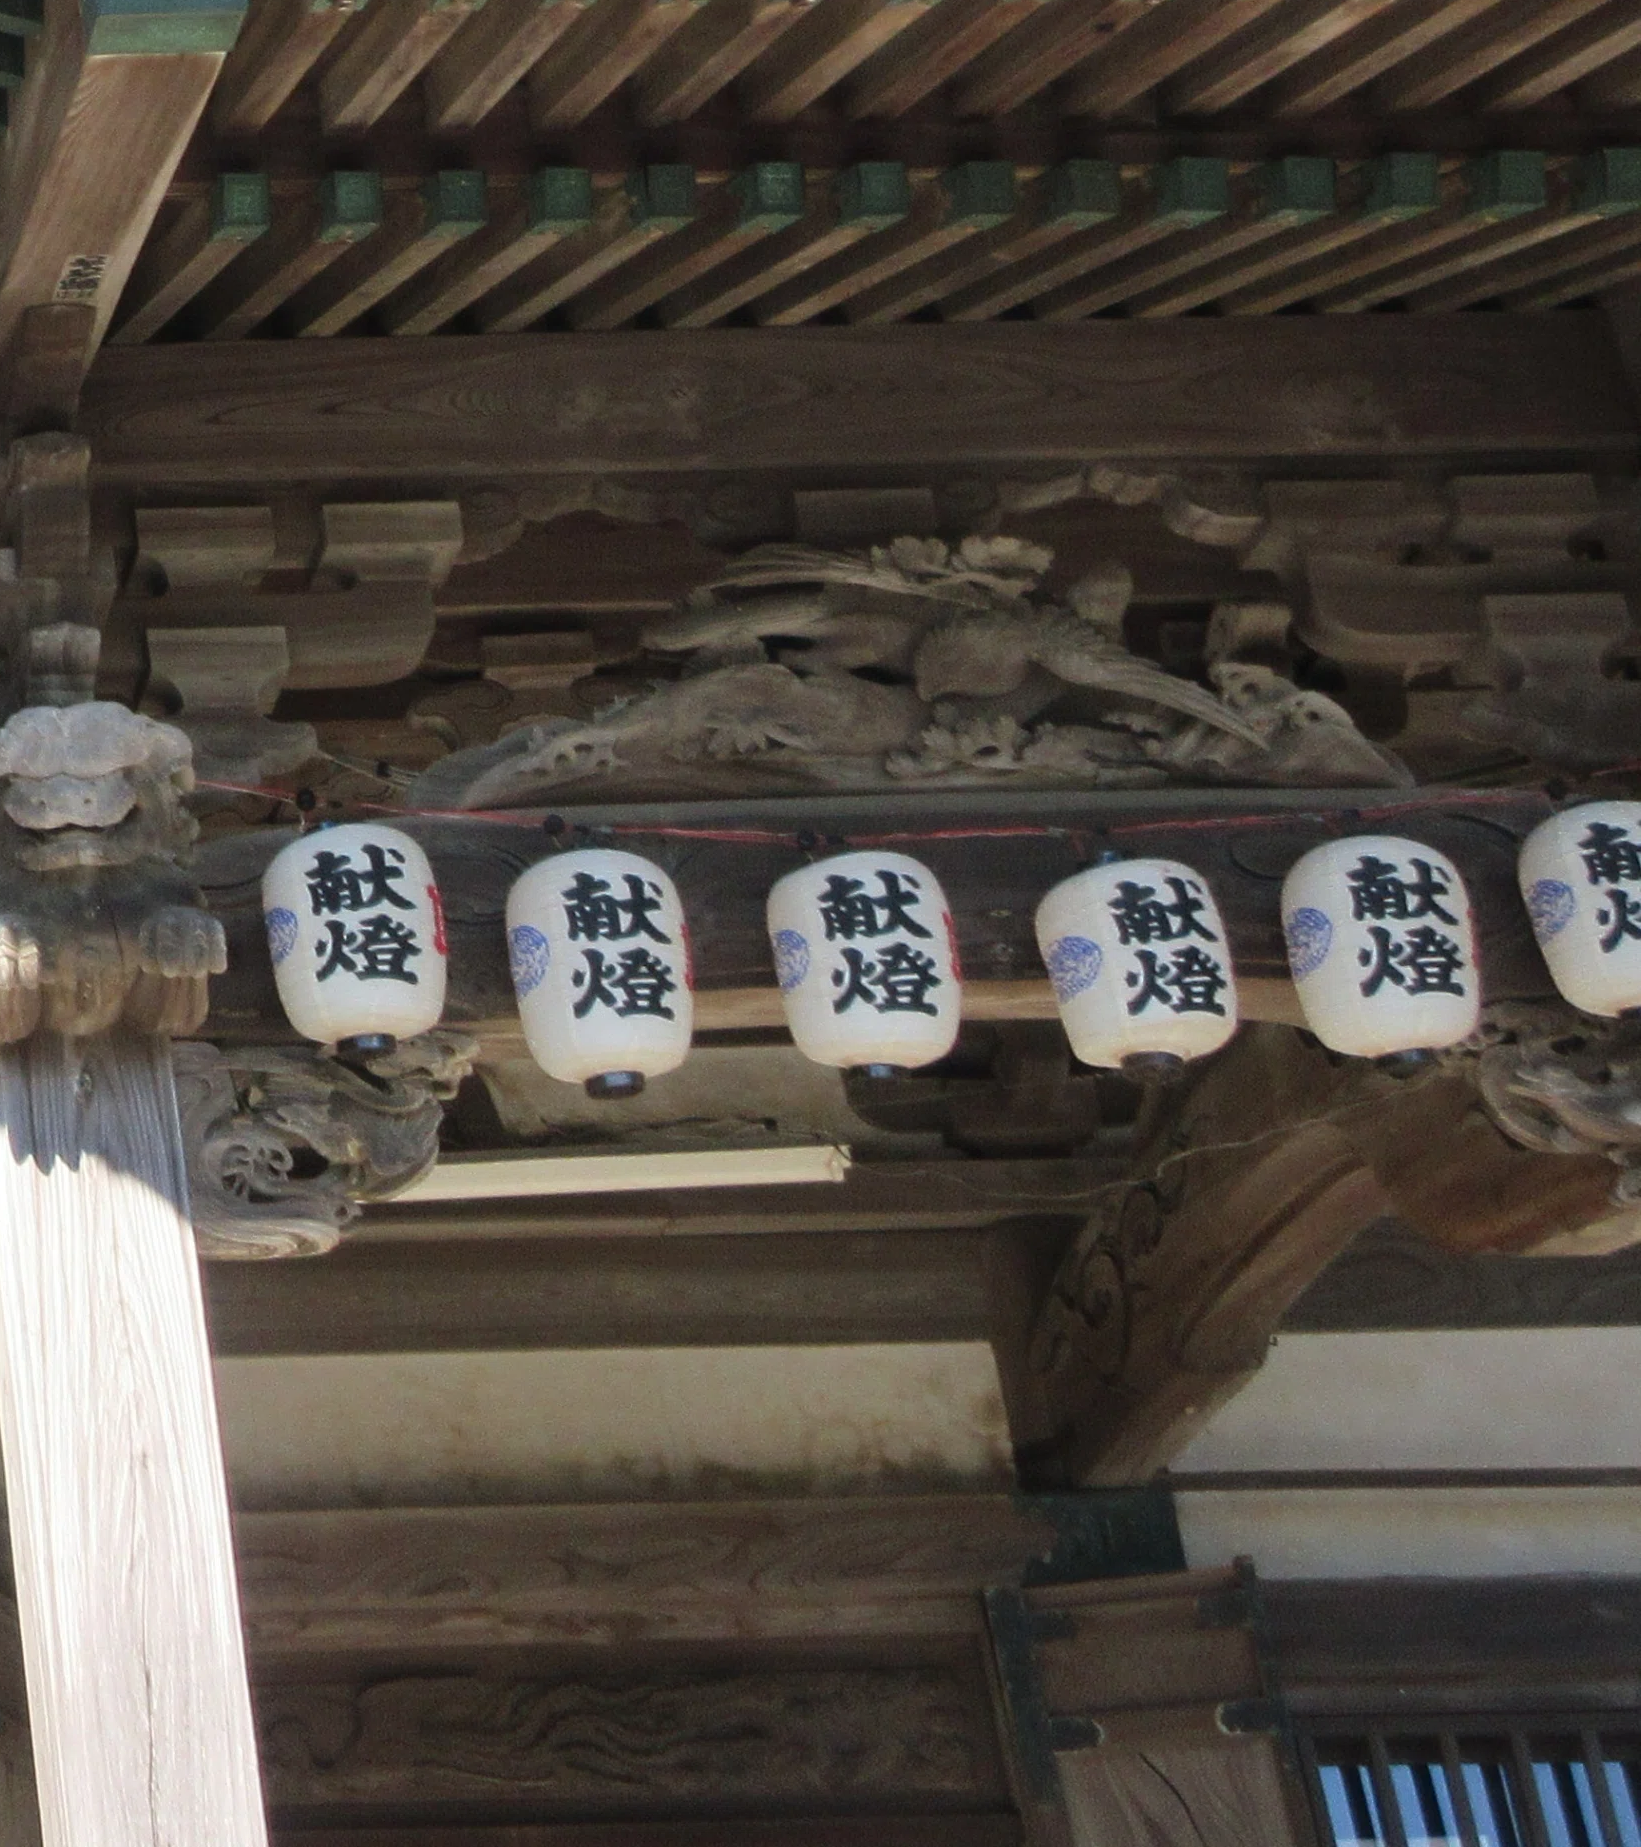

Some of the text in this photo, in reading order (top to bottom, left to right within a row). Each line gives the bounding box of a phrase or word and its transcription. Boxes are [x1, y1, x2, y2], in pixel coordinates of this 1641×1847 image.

[305, 845, 421, 984] 献燈
[563, 873, 676, 1019] 献燈
[818, 871, 941, 1016] 献燈
[1108, 877, 1227, 1016] 献燈
[1347, 856, 1464, 997] 献燈
